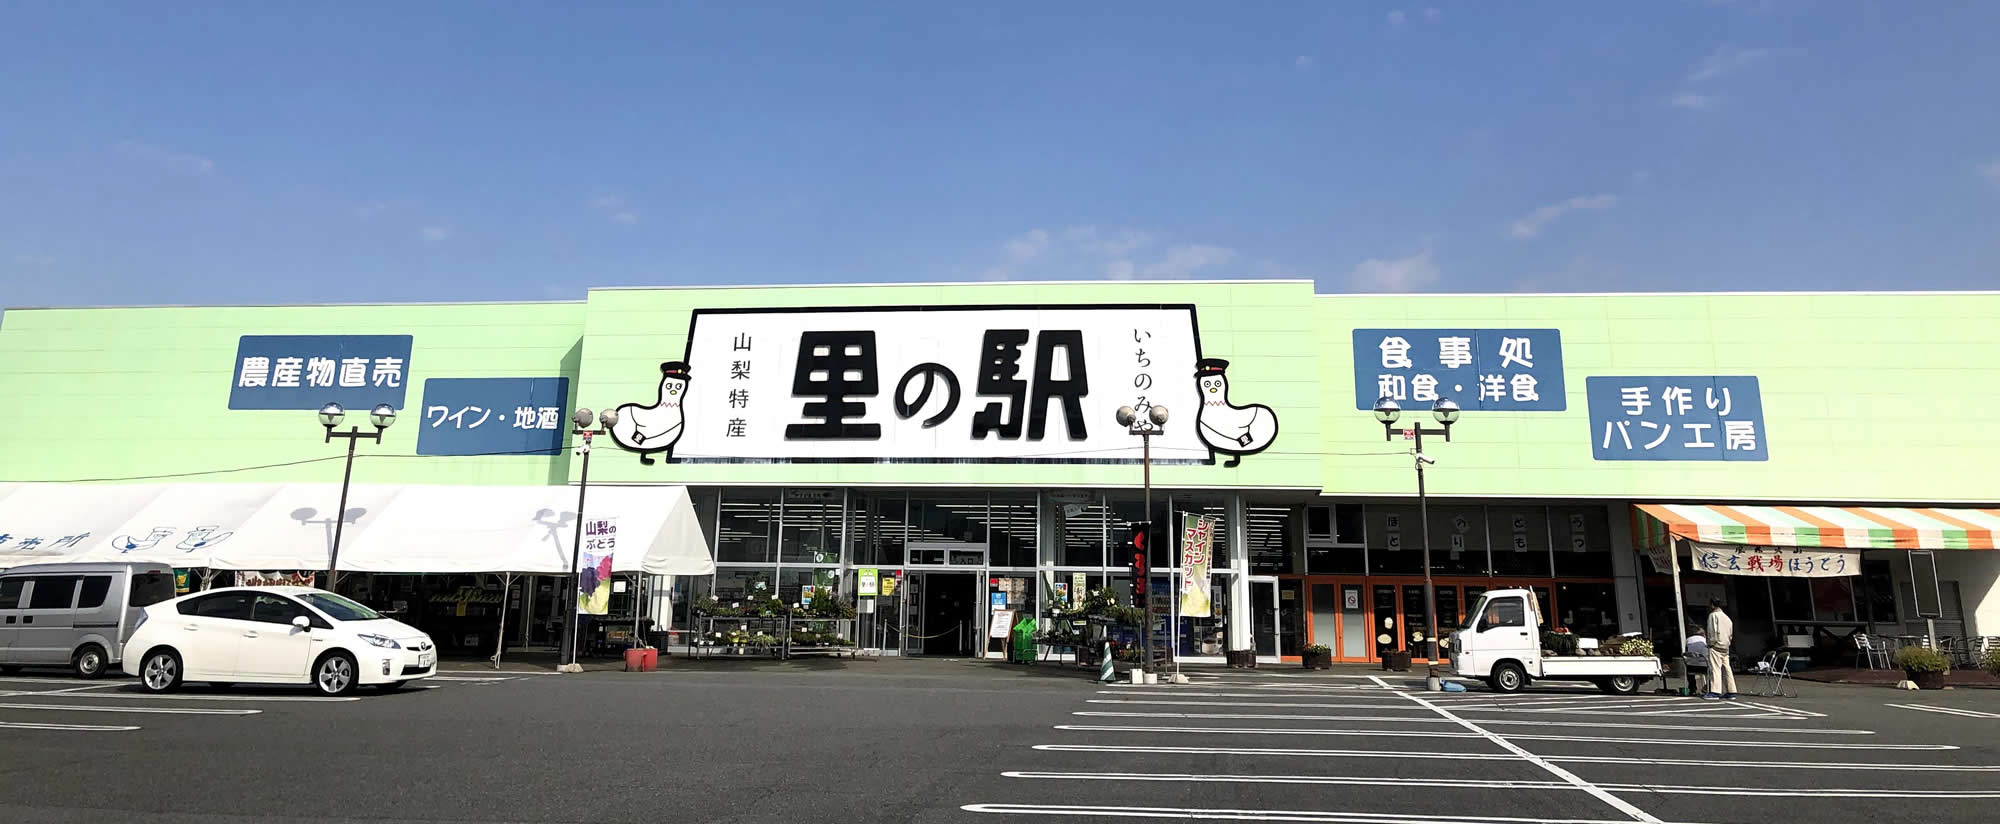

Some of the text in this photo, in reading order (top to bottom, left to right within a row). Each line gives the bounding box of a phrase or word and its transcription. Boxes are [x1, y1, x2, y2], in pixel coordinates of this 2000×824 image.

[1378, 336, 1534, 368] 食事処
[238, 356, 403, 388] 農産物直売
[726, 332, 752, 437] 山梨特産
[784, 329, 1088, 440] 里の駅
[1133, 328, 1154, 431] いちのみや
[1378, 373, 1539, 402] 和食・洋食
[1620, 386, 1732, 416] 手作り
[427, 405, 559, 431] ワイン・地酒
[1602, 420, 1756, 450] パン工房
[586, 520, 617, 536] 山梨の
[586, 538, 615, 550] ぶどう
[1194, 519, 1208, 564] シャイン
[1184, 528, 1196, 589] マスカット
